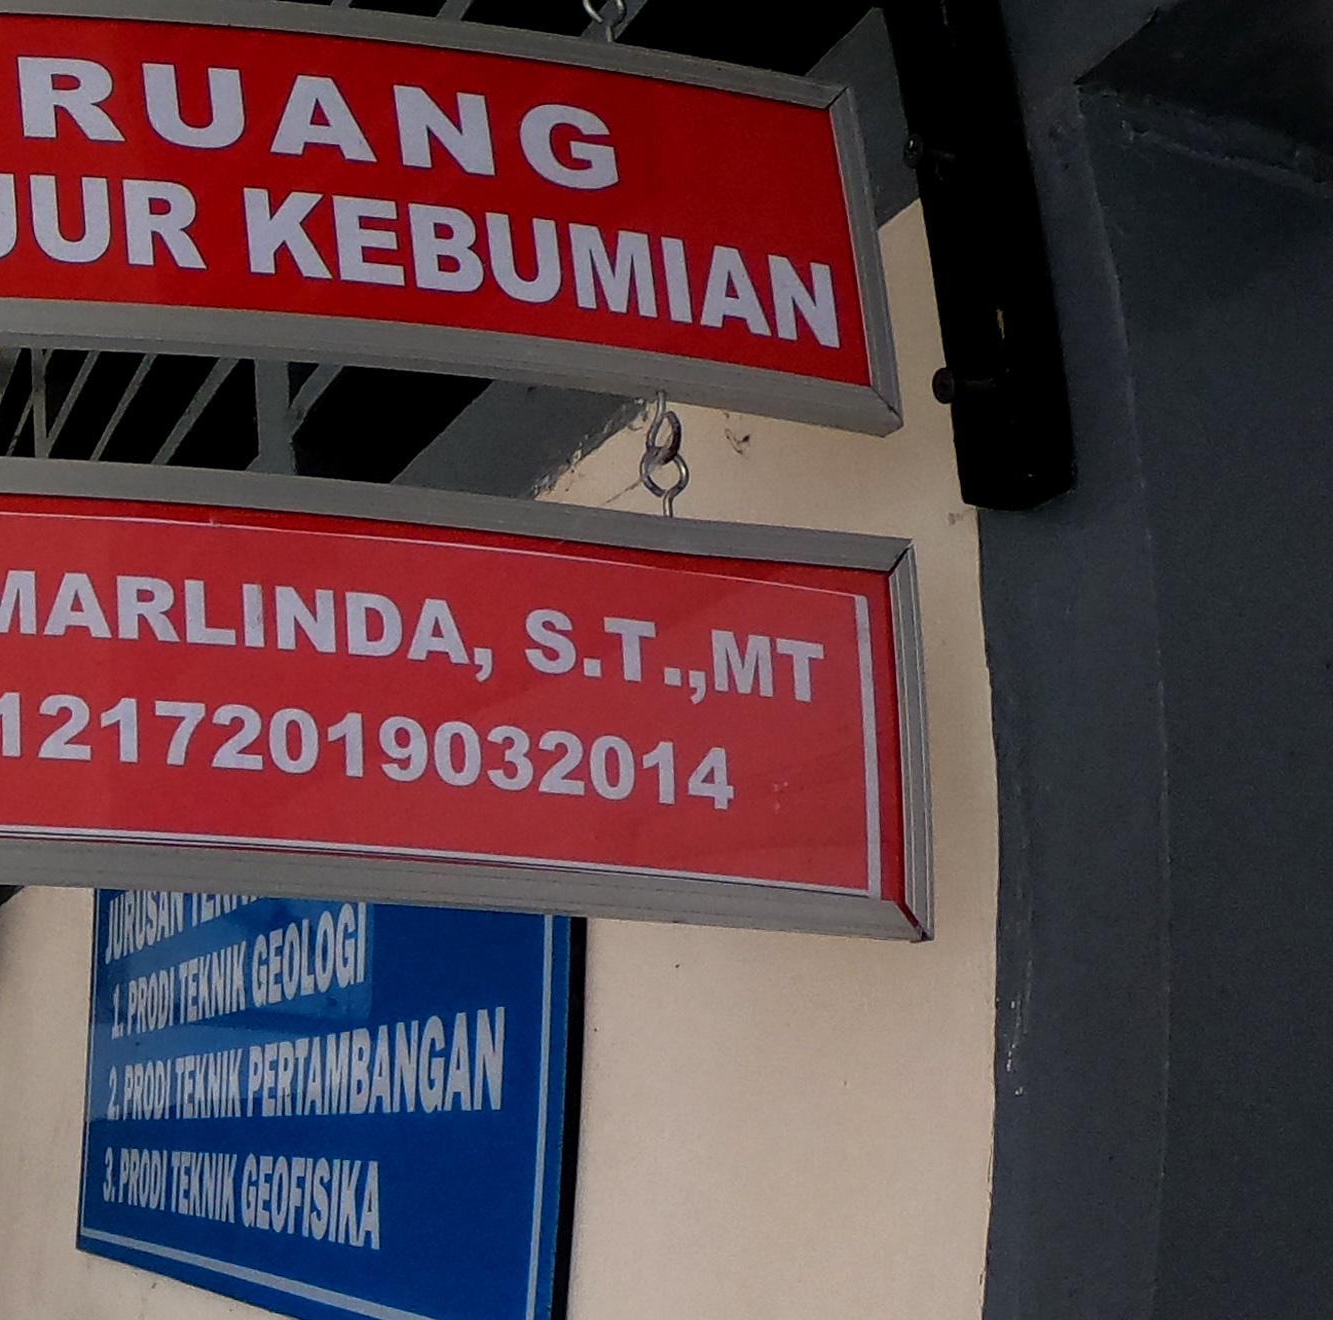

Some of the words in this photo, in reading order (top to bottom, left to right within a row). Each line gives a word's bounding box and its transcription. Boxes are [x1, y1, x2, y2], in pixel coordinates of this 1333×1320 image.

[17, 55, 620, 191] RUANG
[242, 186, 841, 350] KEBUMIAN
[524, 608, 826, 705] S.T.,MT
[105, 889, 183, 965] JURUSAN
[111, 984, 123, 1039] 1.
[127, 969, 175, 1037] PRODI
[178, 940, 247, 1024] TEKNIK
[252, 902, 367, 1004] GEOLOGI
[108, 1064, 121, 1121] 2.
[123, 1059, 171, 1121] PRODI
[175, 1050, 241, 1119] TEKNIK
[246, 1006, 506, 1118] PERTAMBANGAN
[102, 1147, 117, 1202] 3.
[119, 1148, 168, 1212] PRODI
[170, 1151, 237, 1224] TEKNIK
[241, 1153, 381, 1251] GEOFISIKA
